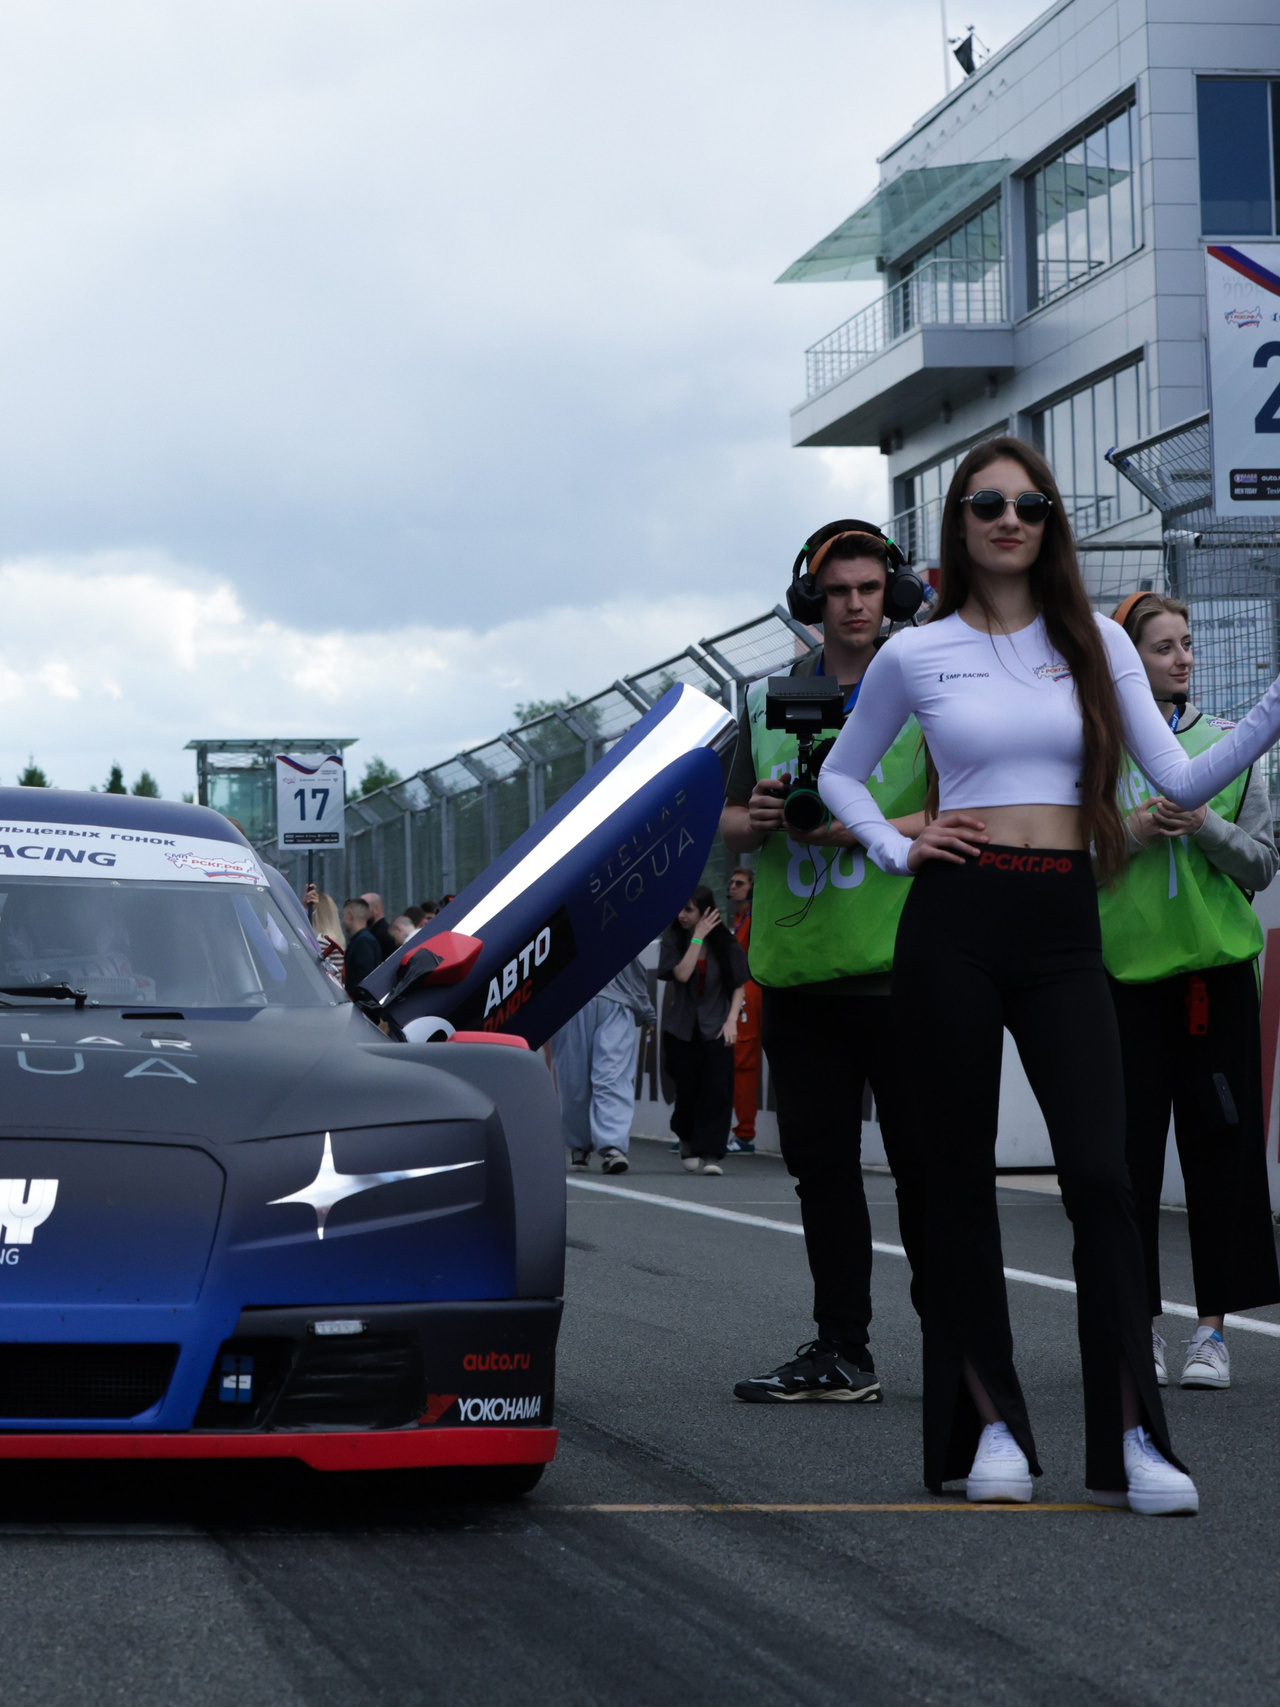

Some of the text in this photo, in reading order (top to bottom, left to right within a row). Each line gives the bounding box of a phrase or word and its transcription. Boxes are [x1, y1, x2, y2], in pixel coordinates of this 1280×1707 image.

[294, 788, 330, 821] 17
[110, 833, 177, 847] гонок
[191, 858, 244, 872] РСКГ.РФ
[978, 851, 1073, 874] РСКГ.РФ
[600, 827, 695, 932] AQUA
[483, 926, 551, 1019] АВТО
[463, 1351, 531, 1371] auto.ru
[458, 1395, 541, 1422] YOKOHAMA
